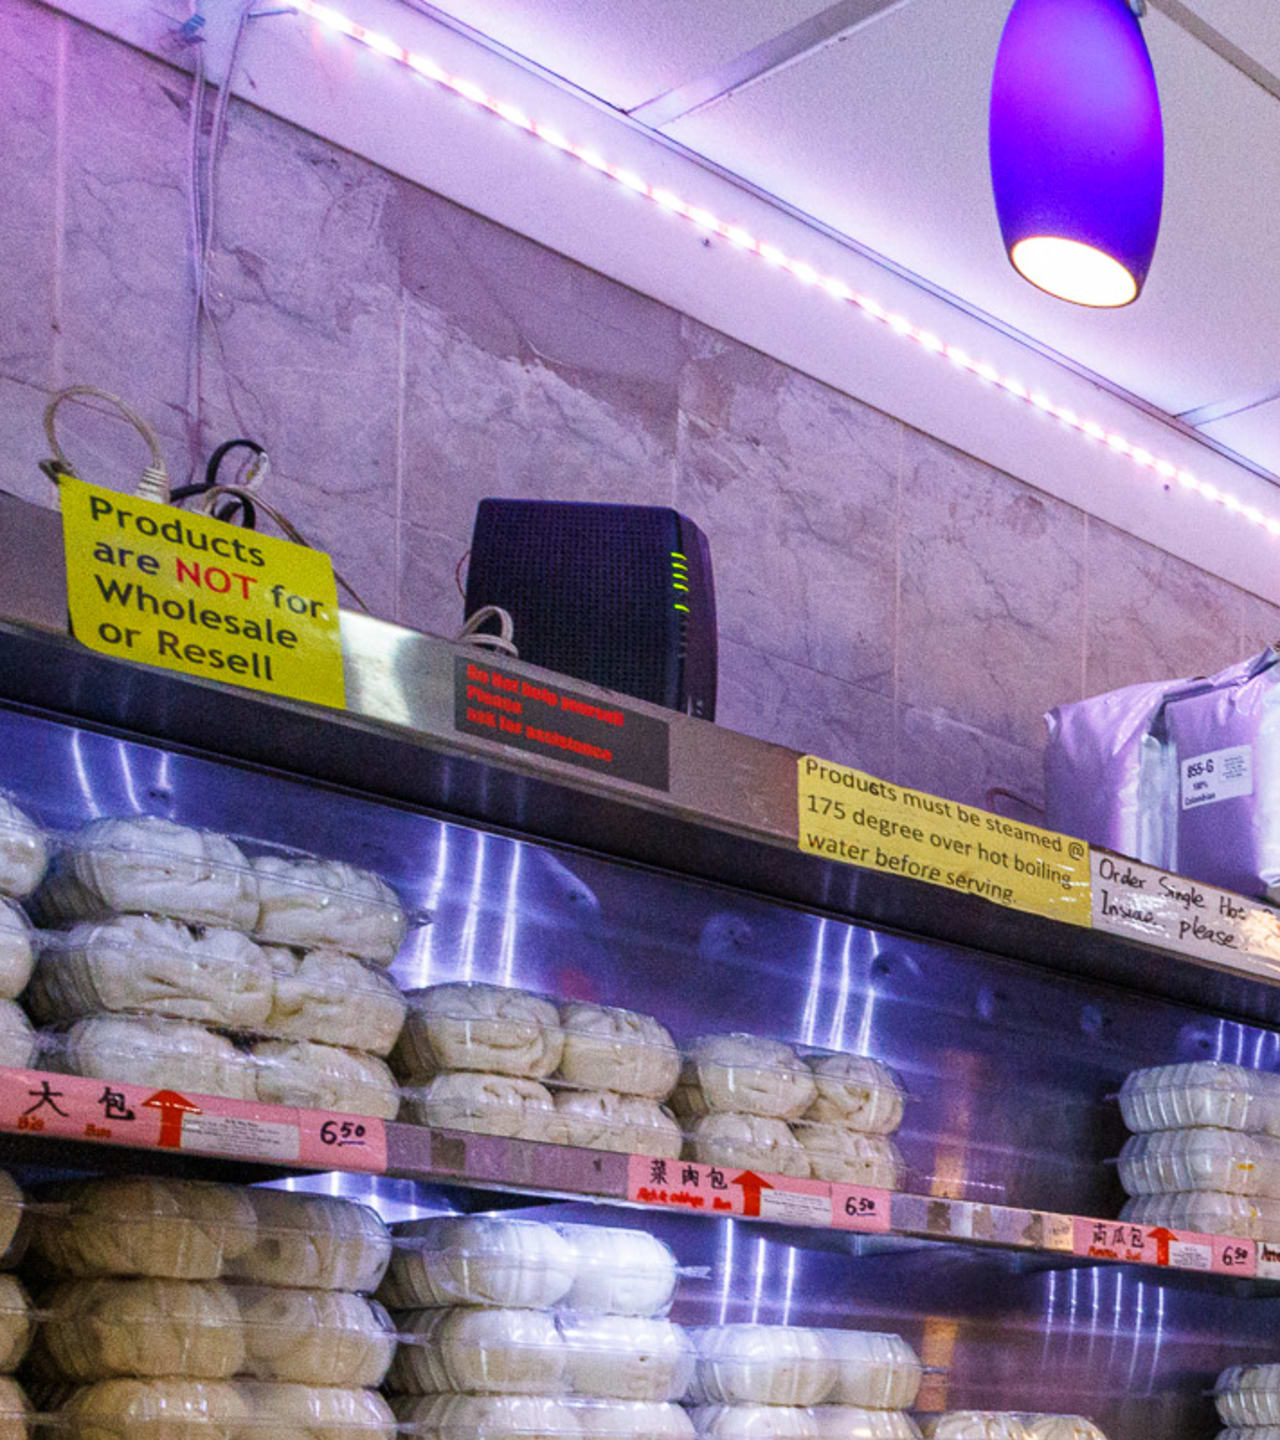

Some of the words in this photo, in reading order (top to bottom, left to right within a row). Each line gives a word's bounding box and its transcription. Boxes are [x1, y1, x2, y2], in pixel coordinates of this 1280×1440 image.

[88, 494, 267, 569] Products
[94, 539, 160, 576] are
[175, 556, 258, 600] NOT
[270, 584, 325, 620] for
[94, 574, 299, 650] Wholesale
[98, 622, 142, 648] or
[157, 630, 274, 682] Resell
[467, 663, 490, 685] Do
[499, 714, 523, 735] for
[525, 724, 613, 763] assistance
[805, 758, 897, 803] Products
[902, 790, 952, 819] must
[956, 803, 981, 826] be
[985, 813, 1063, 853] steamed
[1067, 841, 1085, 862] @
[806, 793, 847, 820] 175
[852, 807, 925, 845] degree
[930, 831, 970, 857] over
[976, 841, 1010, 870] hot
[1013, 852, 1073, 890] boiling
[806, 834, 869, 863] water
[875, 845, 941, 883] before
[945, 869, 1017, 905] serving.
[1099, 858, 1148, 889] Order
[1157, 876, 1206, 911] Single
[1219, 895, 1247, 921] Hot
[23, 1081, 136, 1122] 大包
[650, 1158, 729, 1190] 菜肉包
[1092, 1223, 1145, 1249] 南瓜包
